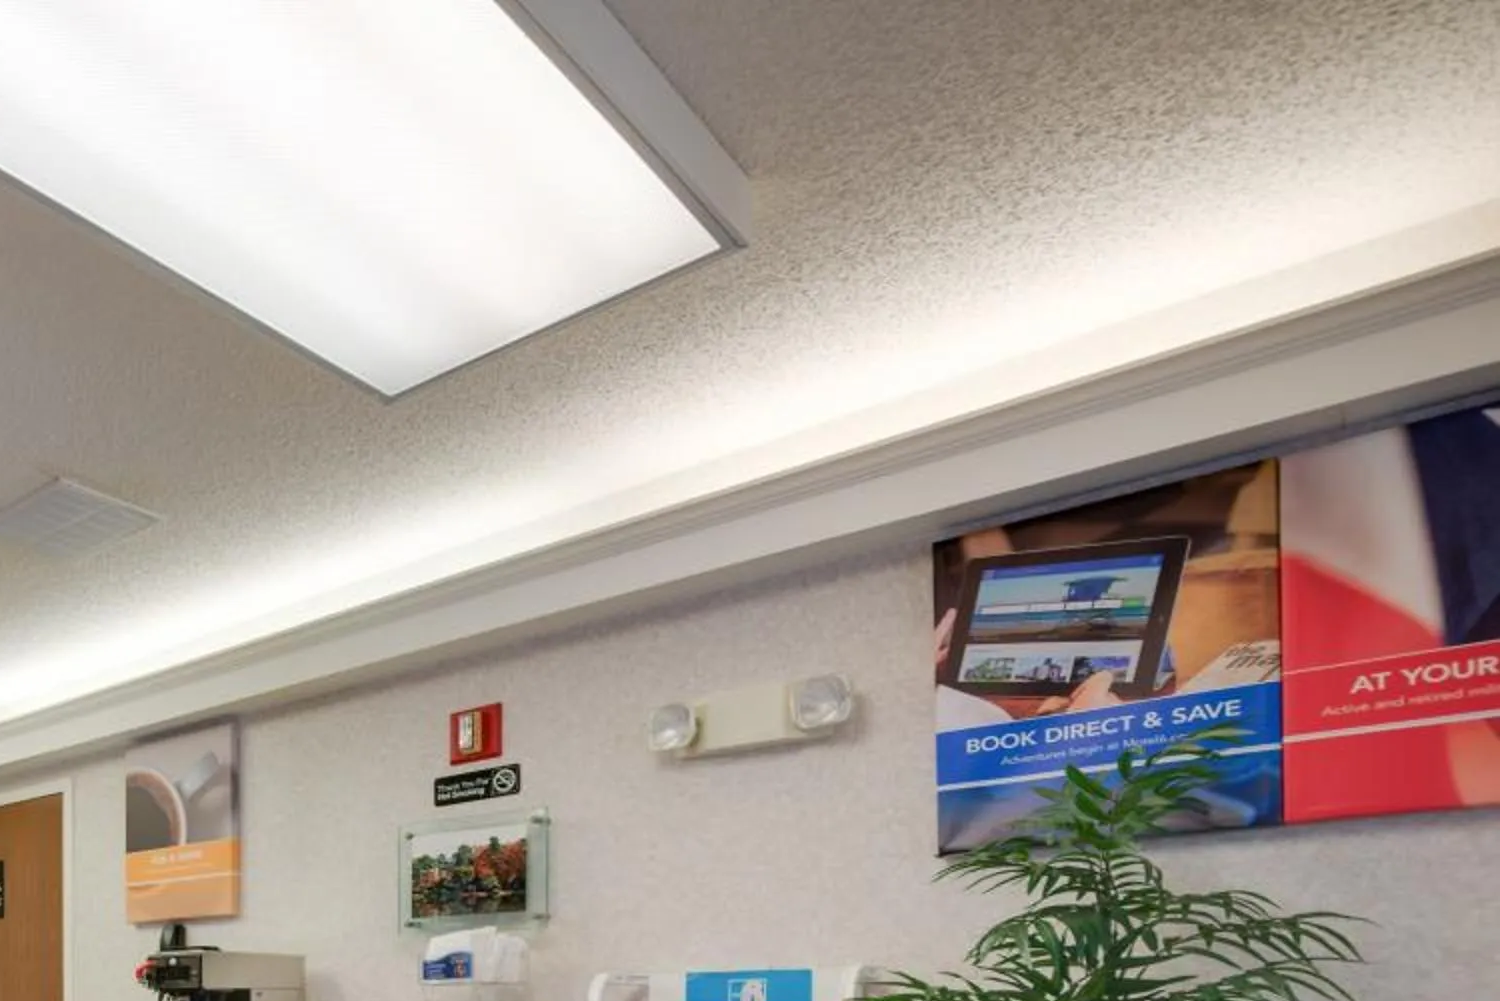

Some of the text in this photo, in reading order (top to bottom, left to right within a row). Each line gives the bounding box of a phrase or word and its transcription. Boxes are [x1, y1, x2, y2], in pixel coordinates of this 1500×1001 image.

[1351, 656, 1500, 694] AT YOUR
[1321, 702, 1371, 717] Active
[1373, 696, 1405, 711] and
[965, 699, 1242, 754] BOOK DIRECT & SAVE
[1000, 751, 1066, 766] Adventures
